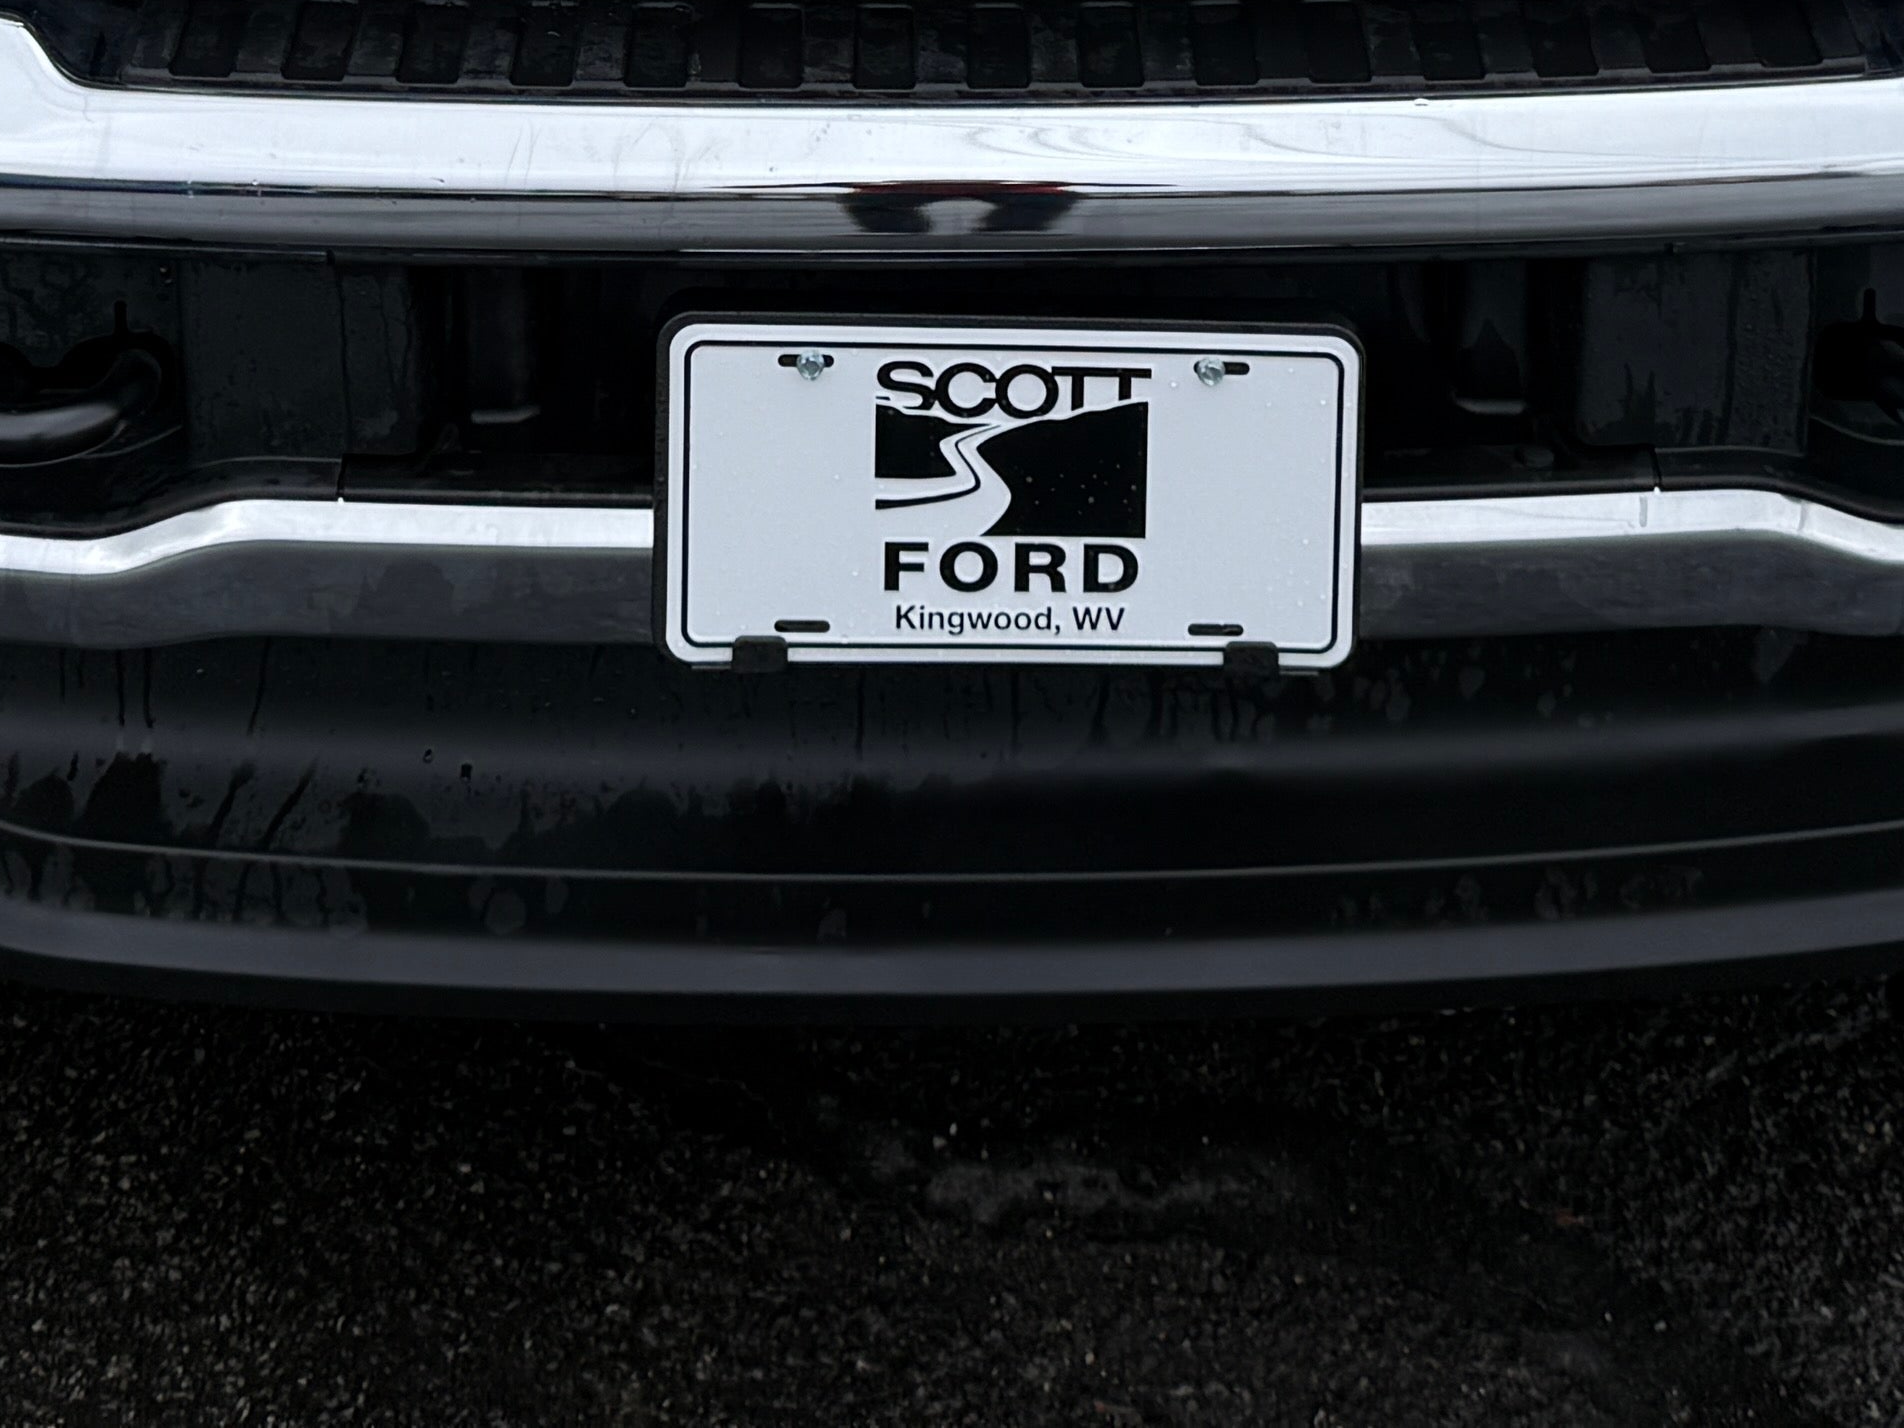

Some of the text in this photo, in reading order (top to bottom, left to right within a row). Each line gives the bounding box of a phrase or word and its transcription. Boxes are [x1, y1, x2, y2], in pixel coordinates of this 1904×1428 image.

[876, 361, 1152, 419] SCOTT
[884, 541, 1139, 593] FORD
[896, 605, 1126, 635] Kingwood, WV
